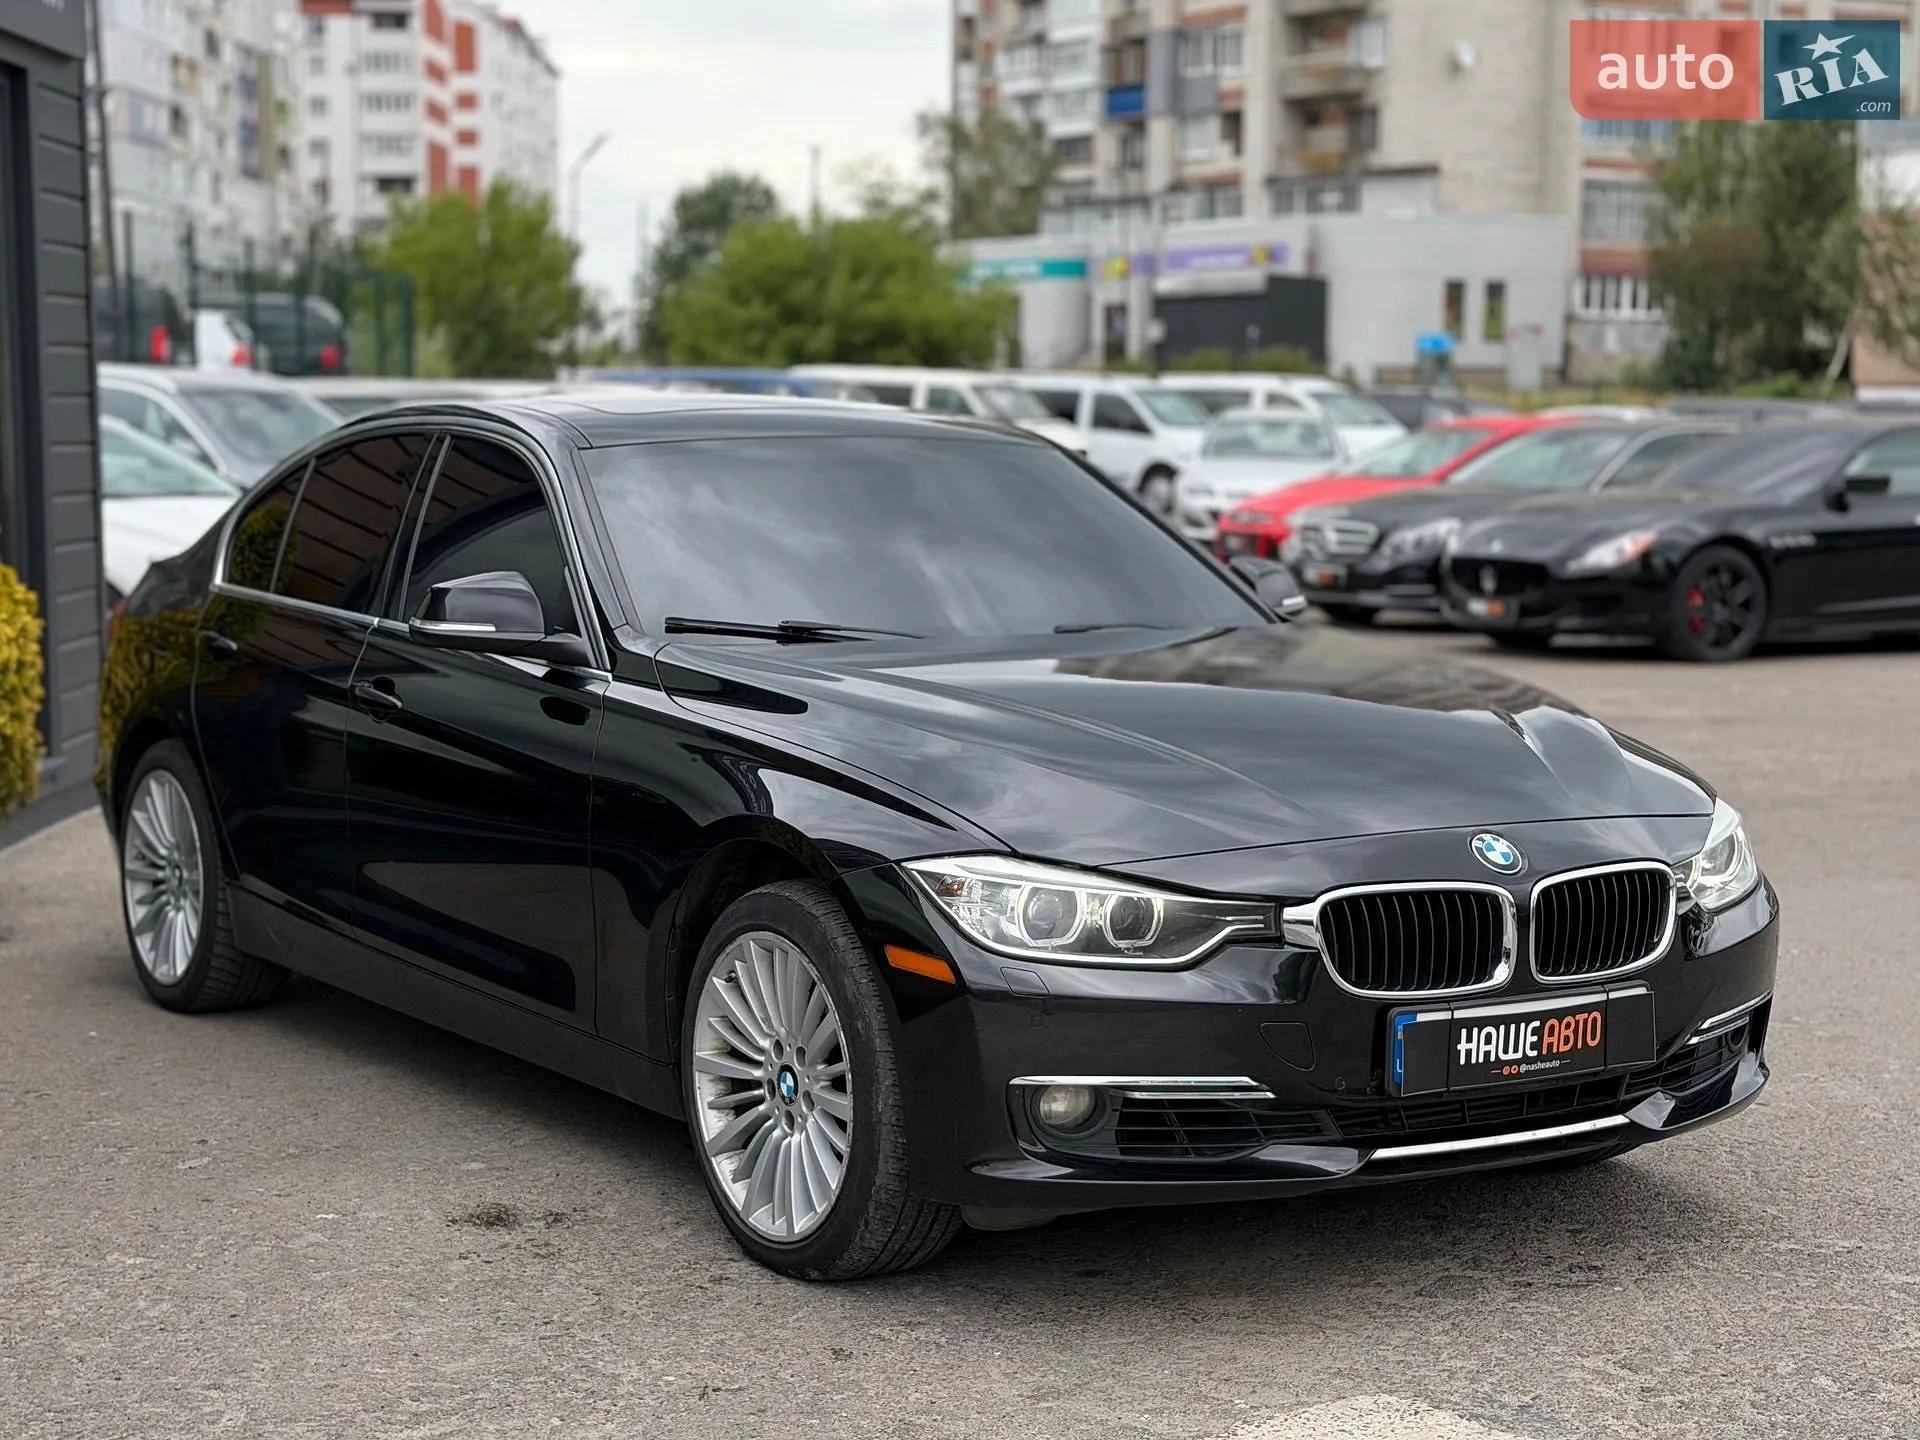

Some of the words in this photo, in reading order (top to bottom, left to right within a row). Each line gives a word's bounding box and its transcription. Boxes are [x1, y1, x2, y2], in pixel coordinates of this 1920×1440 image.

[1456, 1020, 1541, 1065] НАШЕ
[1541, 1010, 1602, 1056] АВТО
[1519, 1059, 1561, 1074] @nasheauto
